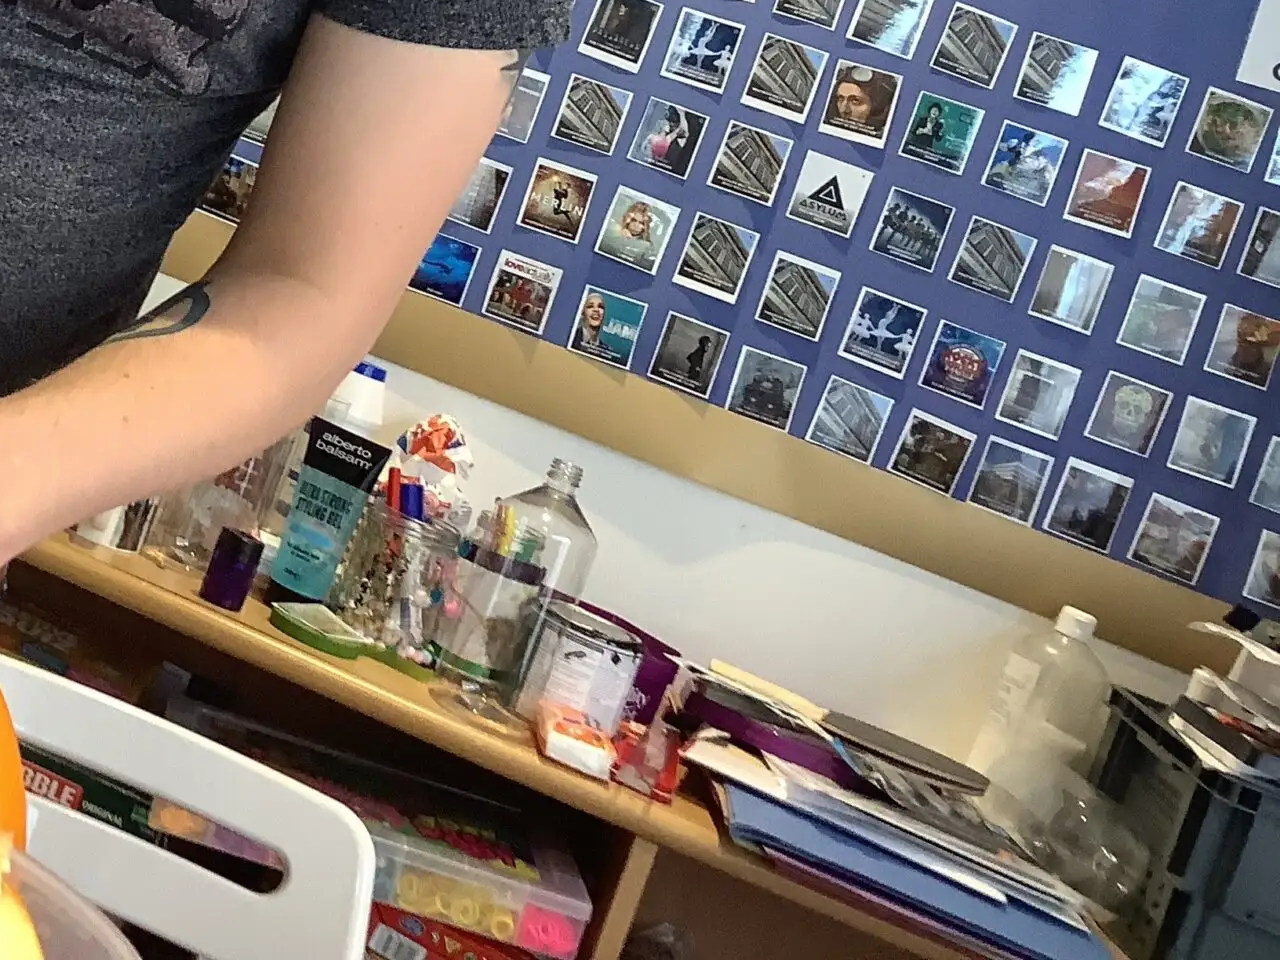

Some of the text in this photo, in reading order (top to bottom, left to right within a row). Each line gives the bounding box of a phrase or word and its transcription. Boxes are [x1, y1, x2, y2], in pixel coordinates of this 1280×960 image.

[530, 191, 584, 217] MERLIN
[799, 199, 848, 221] ASYLUM
[315, 439, 372, 470] balsam
[322, 431, 372, 458] alberto
